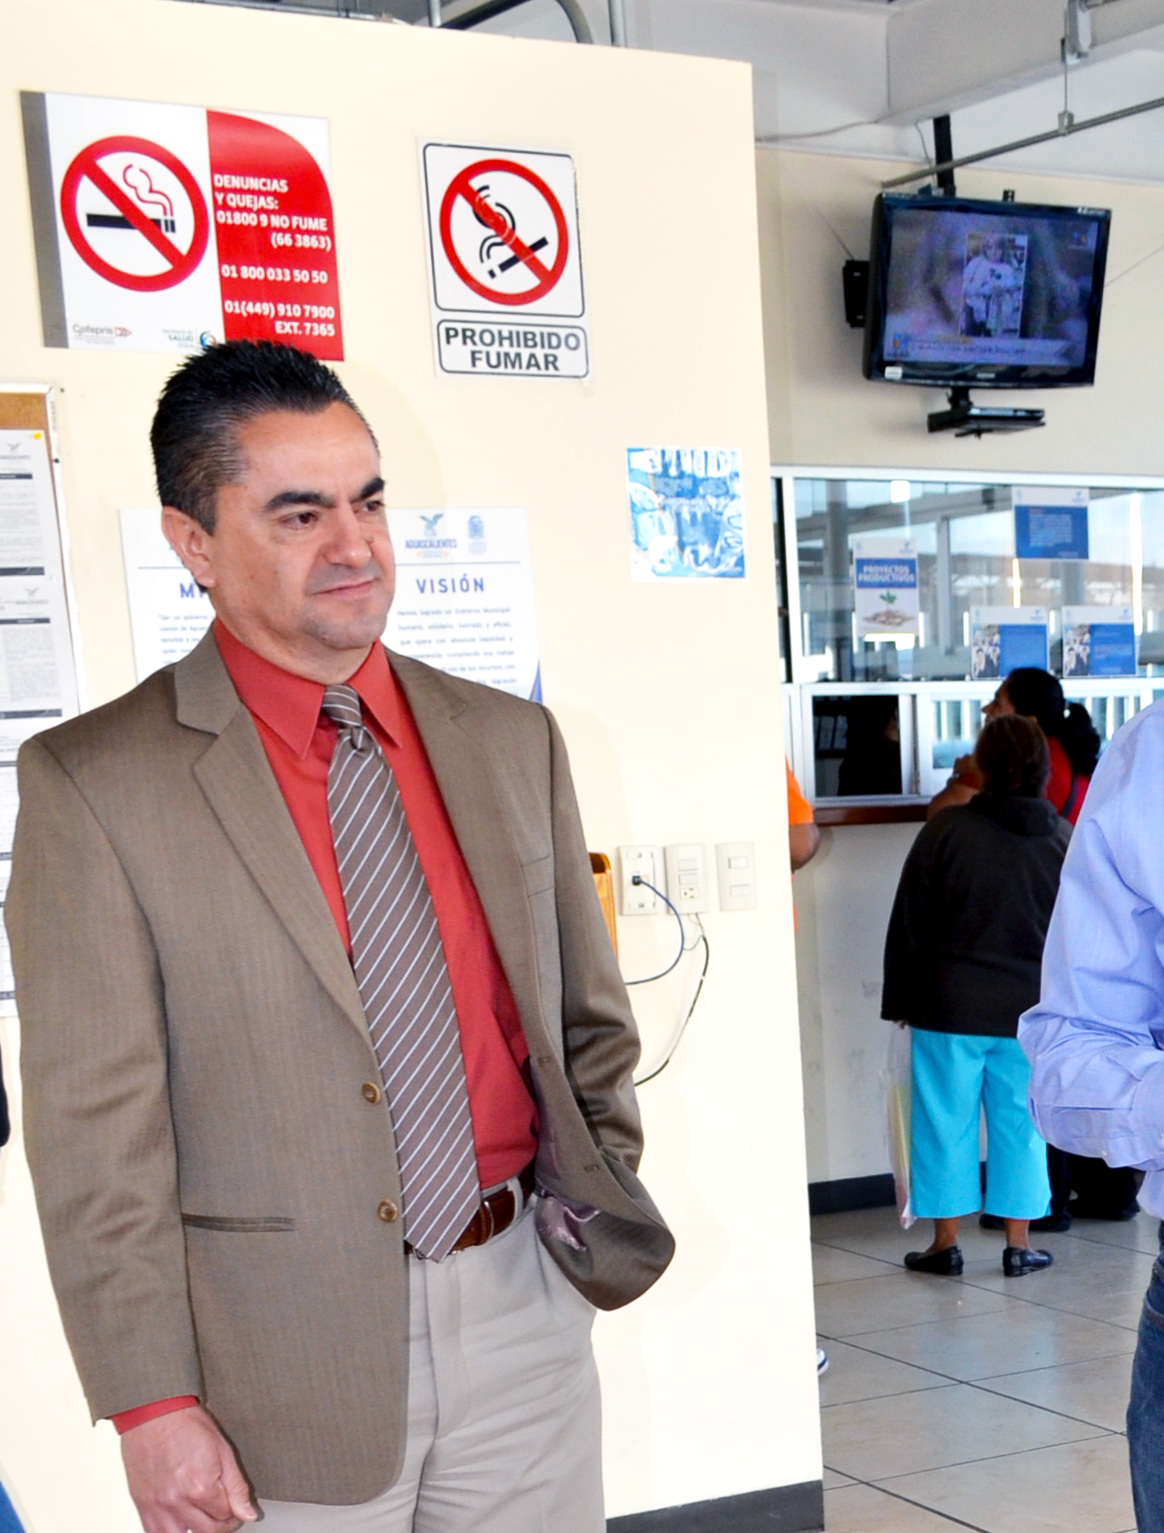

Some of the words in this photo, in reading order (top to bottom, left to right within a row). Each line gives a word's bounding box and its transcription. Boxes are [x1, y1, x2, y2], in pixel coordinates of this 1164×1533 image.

[214, 174, 288, 193] DENUNCIAS
[215, 192, 224, 206] Y
[226, 193, 279, 211] QUEJAS:
[216, 210, 258, 226] 01800
[259, 213, 268, 227] 9
[270, 214, 290, 229] NO
[292, 216, 328, 231] FUME
[271, 232, 293, 249] (66
[295, 234, 332, 252] 3863)
[221, 264, 238, 278] 01
[240, 265, 265, 280] 800
[267, 267, 291, 281] 033
[293, 269, 310, 283] 50
[311, 270, 328, 284] 50
[224, 300, 275, 319] 01(449)
[277, 303, 301, 317] 910
[303, 305, 335, 319] 7900
[275, 321, 302, 335] EXT.
[304, 322, 335, 337] 7365
[444, 326, 582, 351] PROHIBIDO
[470, 350, 560, 372] FUMAR
[416, 573, 485, 594] VISIÓN
